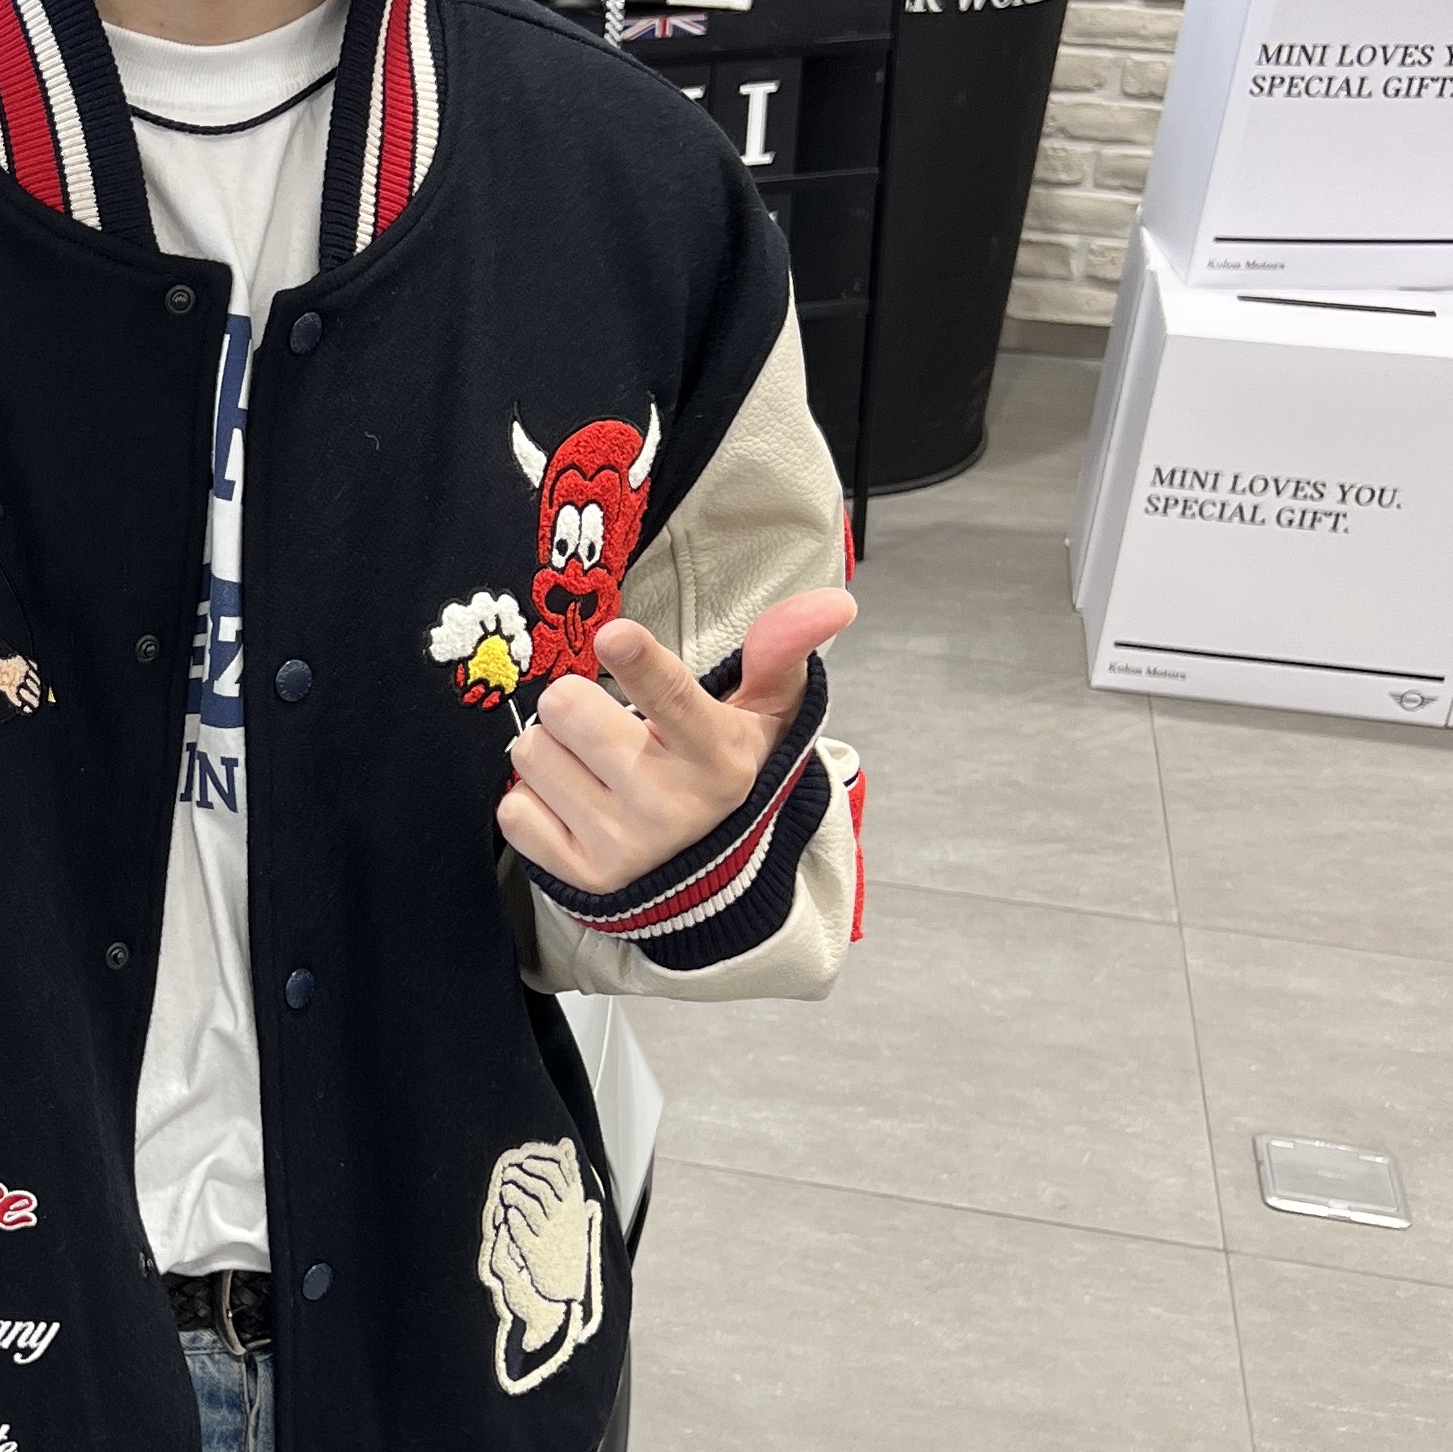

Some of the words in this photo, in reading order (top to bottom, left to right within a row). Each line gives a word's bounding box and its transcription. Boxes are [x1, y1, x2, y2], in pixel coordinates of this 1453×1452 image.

[1255, 42, 1330, 67] MINI
[1336, 43, 1435, 68] LOVES
[1249, 74, 1373, 99] SPECIAL
[1150, 464, 1223, 491] MINI
[1228, 471, 1327, 502] LOVES
[1334, 481, 1403, 510] YOU.
[1145, 493, 1266, 526] SPECIAL
[1275, 506, 1350, 535] GIFT.
